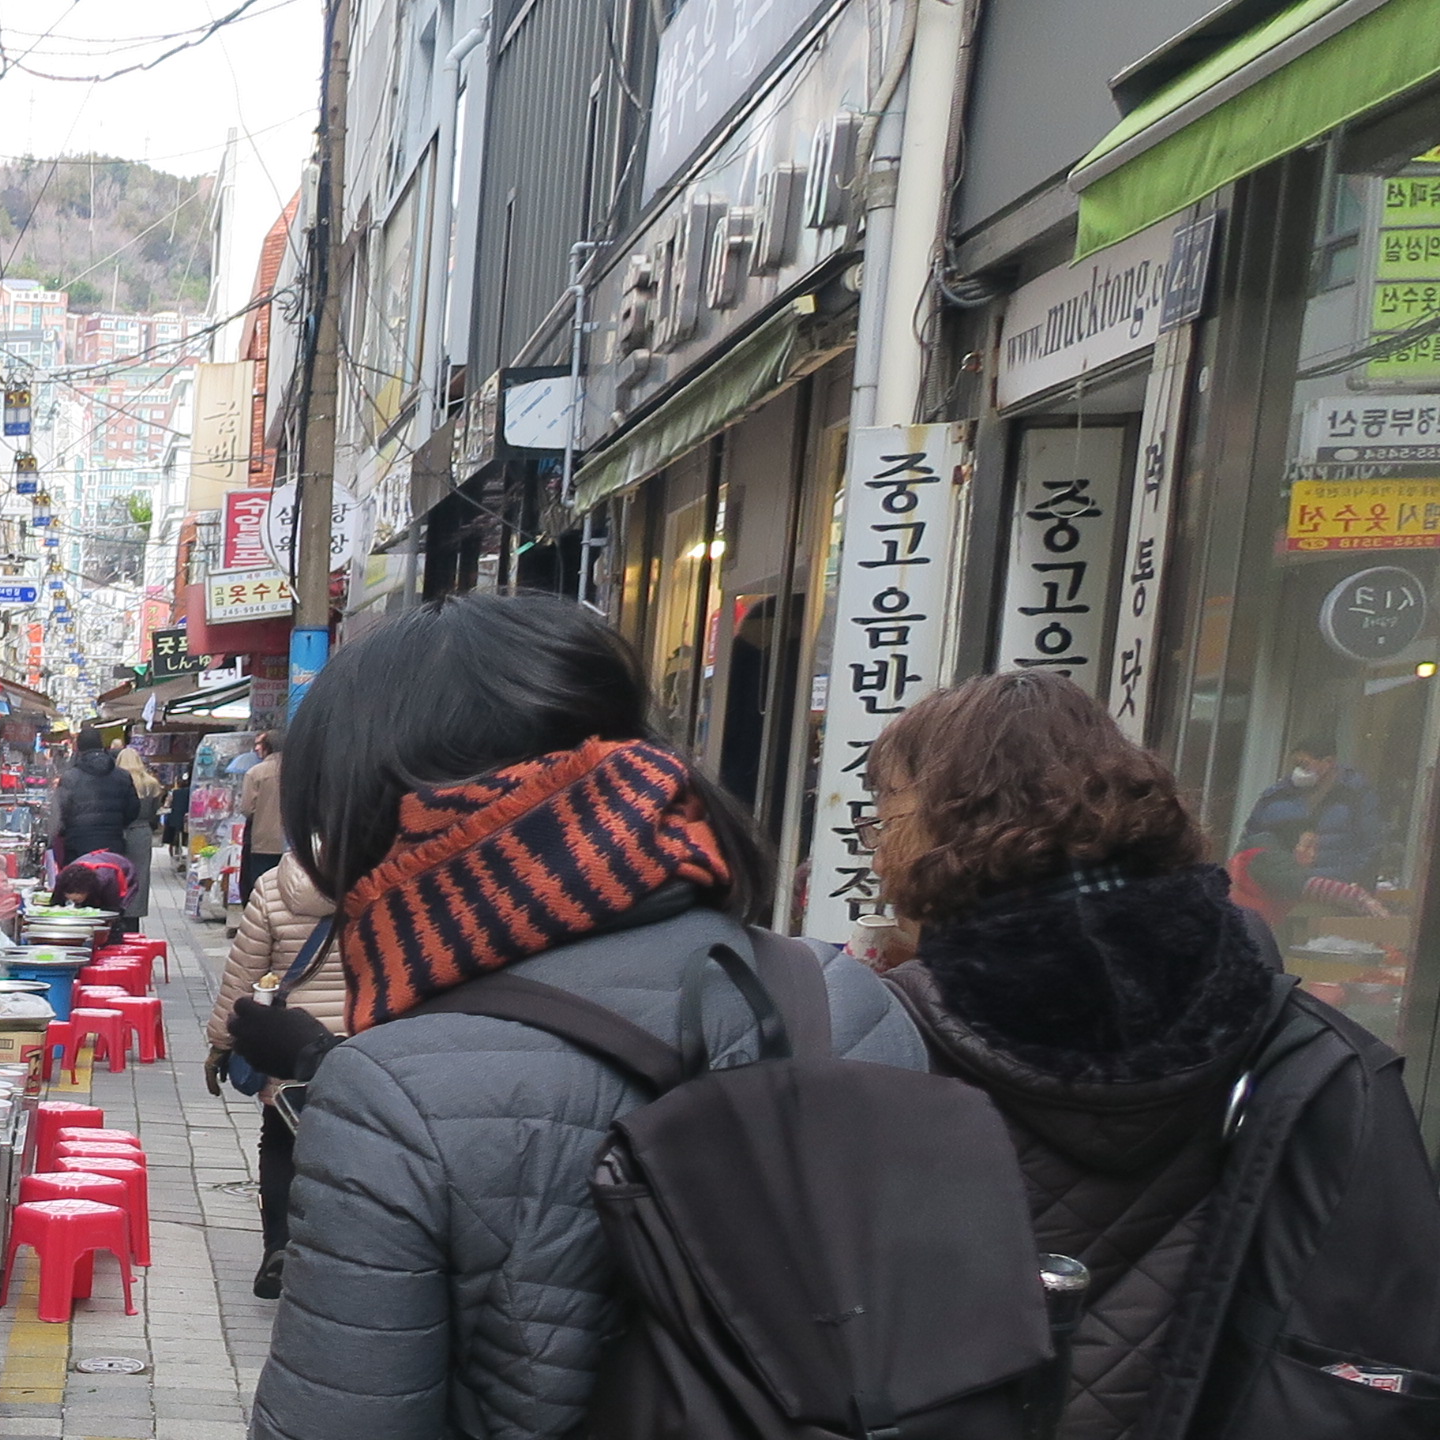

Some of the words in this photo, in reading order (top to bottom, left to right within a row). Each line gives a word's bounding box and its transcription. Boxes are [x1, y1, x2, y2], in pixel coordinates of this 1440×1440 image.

[1006, 260, 1169, 374] www.mucktong.c
[275, 503, 351, 526] 삼탕
[274, 534, 350, 554] 육장
